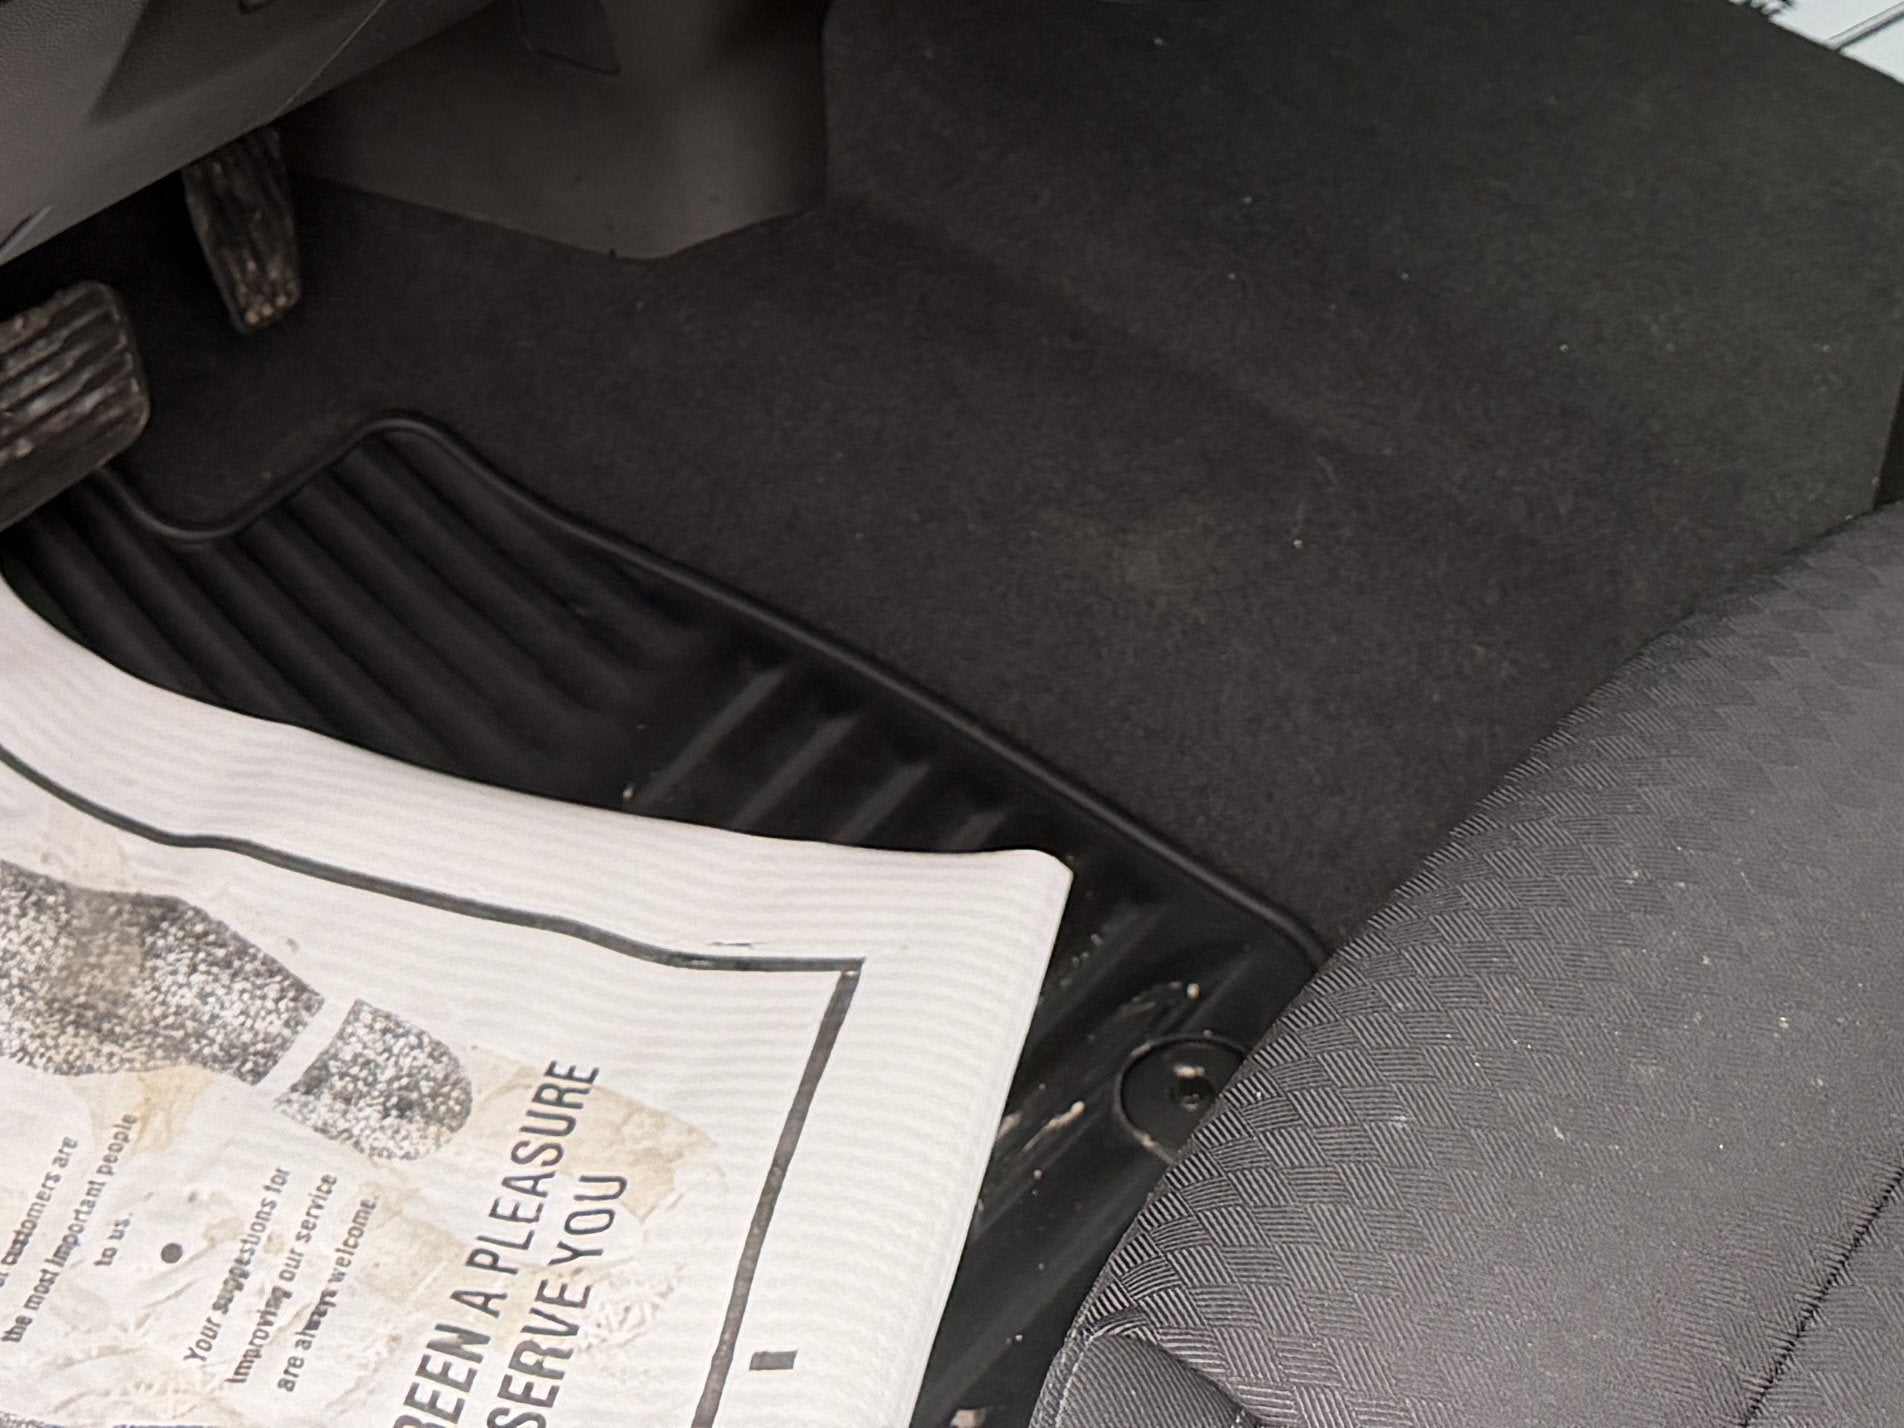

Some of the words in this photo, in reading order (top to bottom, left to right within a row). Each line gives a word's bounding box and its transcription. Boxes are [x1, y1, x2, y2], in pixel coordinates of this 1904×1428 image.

[0, 1171, 62, 1266] customers
[51, 1136, 79, 1169] are
[465, 1060, 600, 1275] PLEASURE
[548, 1175, 627, 1266] YOU
[0, 1314, 33, 1343] the
[23, 1268, 60, 1312] most
[97, 1113, 138, 1176] people
[93, 1246, 118, 1267] to
[183, 1316, 222, 1362] Your
[212, 1197, 277, 1315] suggestions
[263, 1167, 290, 1194] for
[278, 1248, 305, 1282] our
[295, 1174, 337, 1244] service
[450, 1290, 508, 1318] A
[277, 1355, 305, 1393] are
